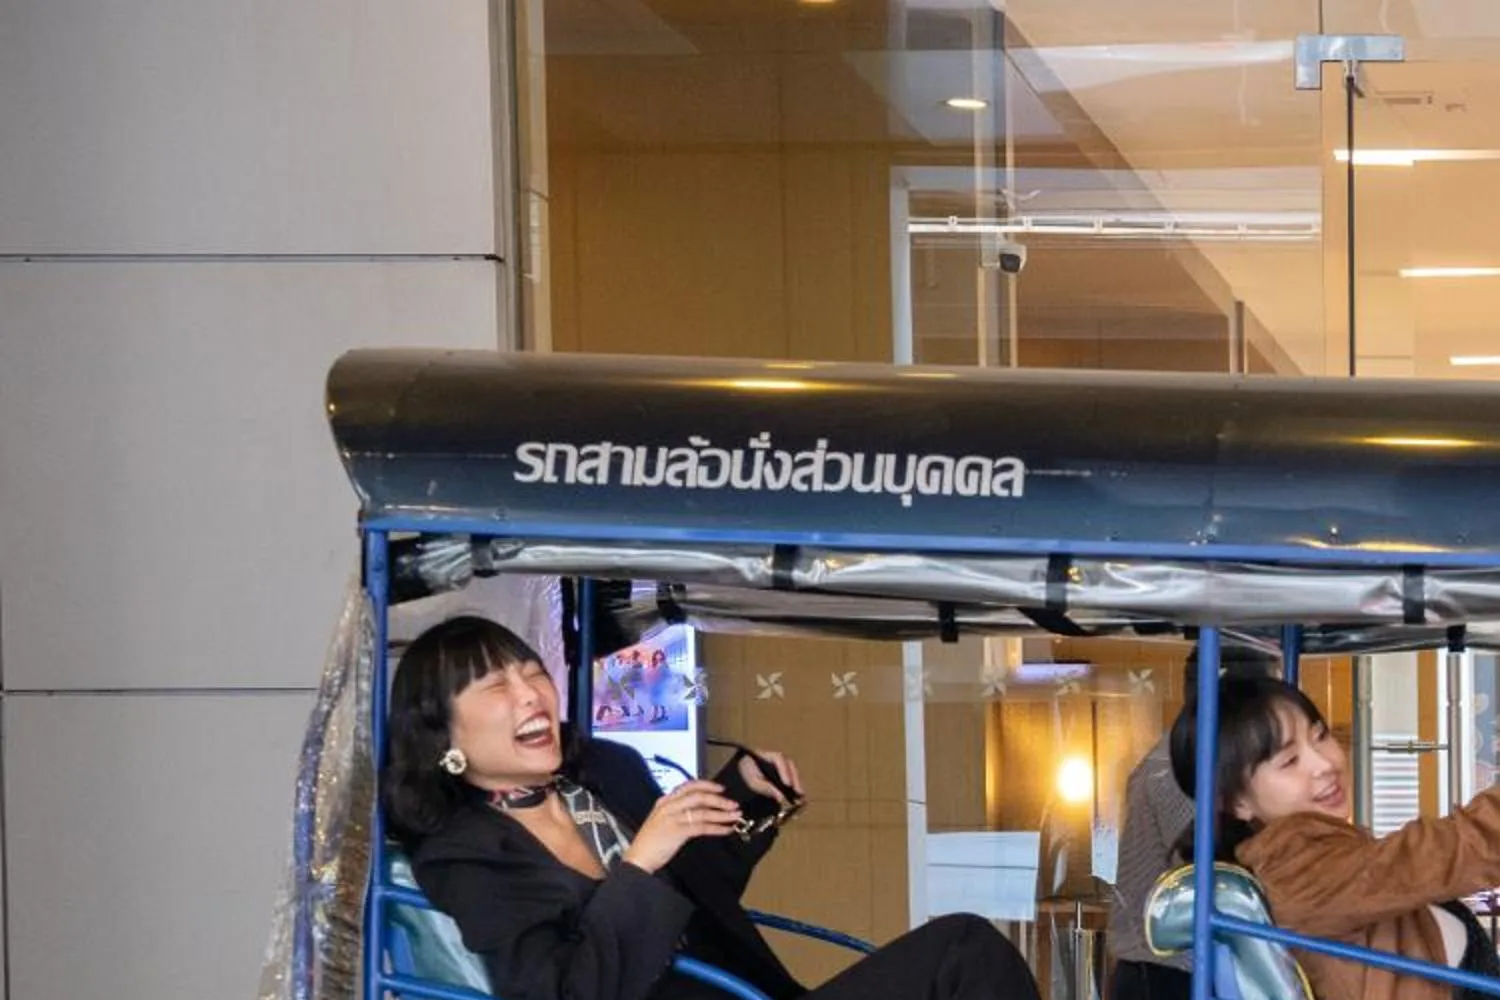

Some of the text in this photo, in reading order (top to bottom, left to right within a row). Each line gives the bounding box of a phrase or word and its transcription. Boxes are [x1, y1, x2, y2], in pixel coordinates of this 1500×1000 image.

[514, 432, 1025, 507] รถสามล้อนั่งส่วนบุคคล
